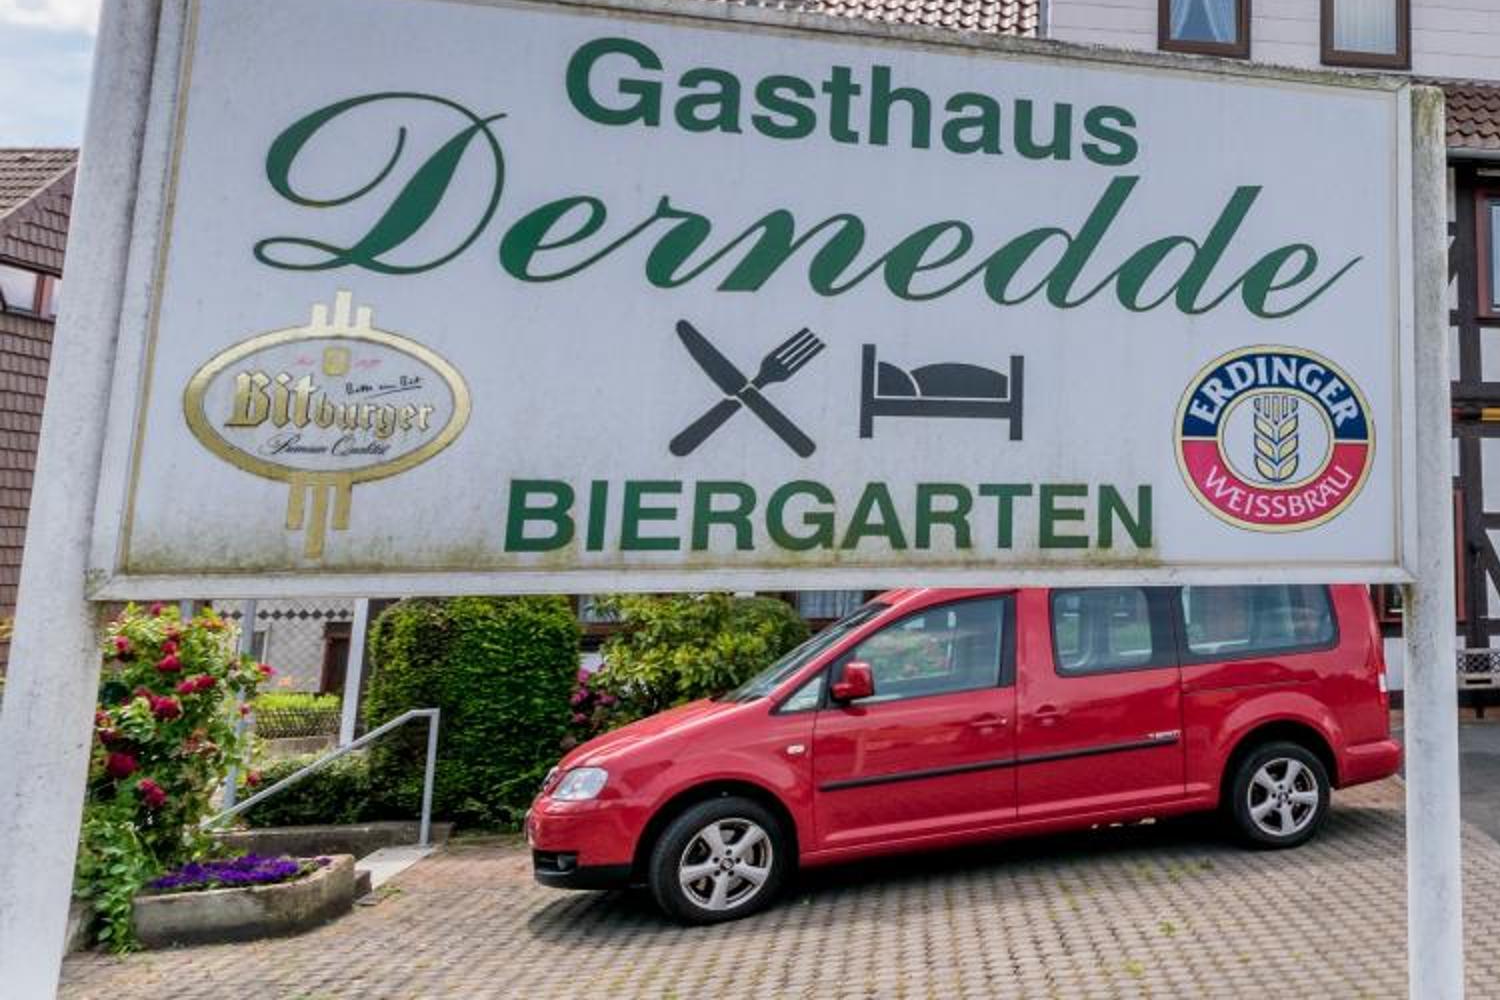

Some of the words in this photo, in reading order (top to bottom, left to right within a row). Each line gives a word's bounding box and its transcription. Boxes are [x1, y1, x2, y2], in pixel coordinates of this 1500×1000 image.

[565, 36, 1140, 166] Gasthaus
[253, 91, 1364, 319] Dernedde
[224, 369, 434, 440] Bitburger
[1188, 355, 1360, 427] ERDINGER
[503, 478, 1154, 554] BIERGARTEN
[1204, 464, 1354, 518] WEISSBRÄU
